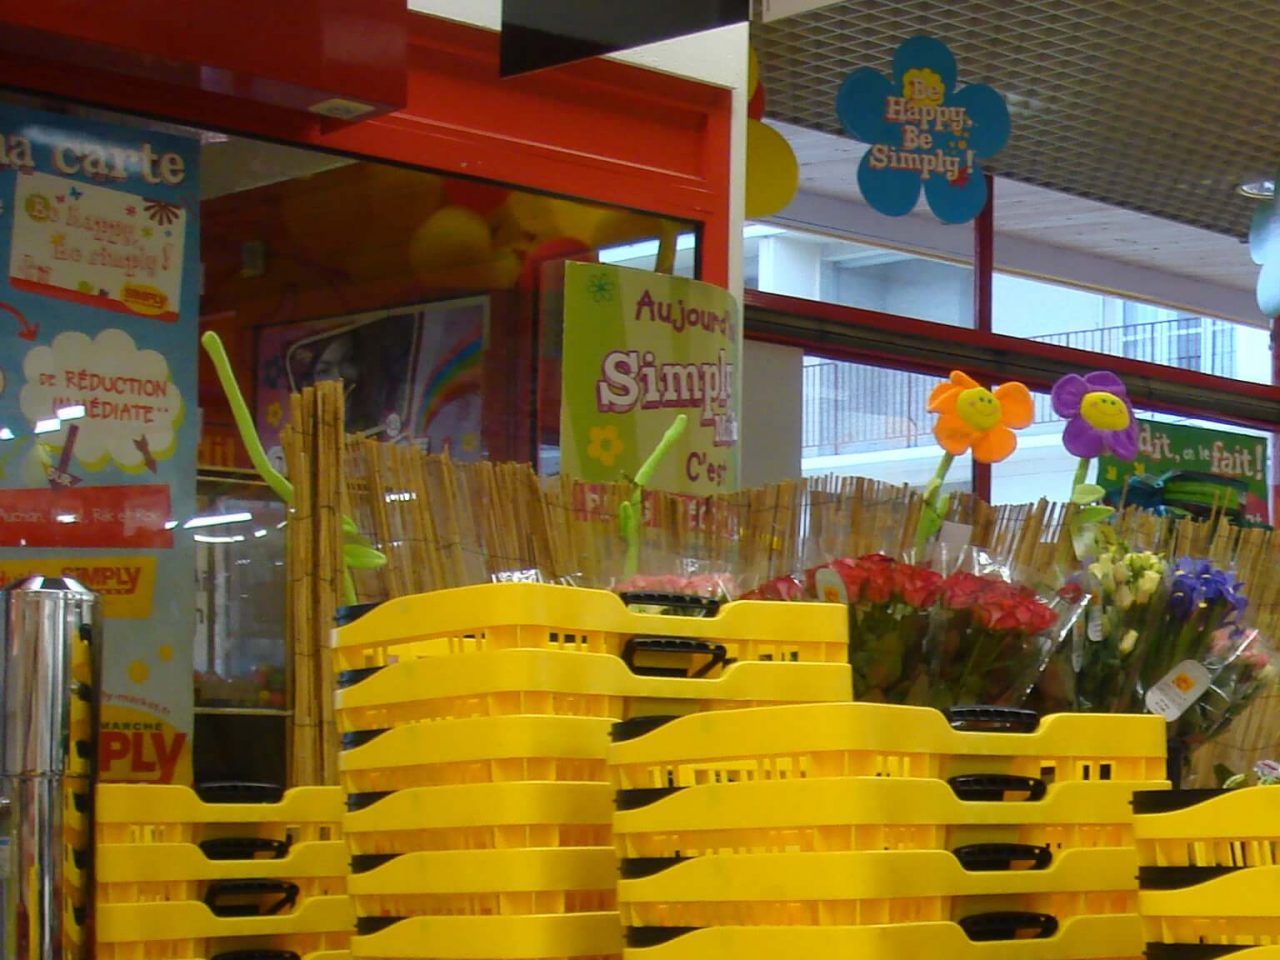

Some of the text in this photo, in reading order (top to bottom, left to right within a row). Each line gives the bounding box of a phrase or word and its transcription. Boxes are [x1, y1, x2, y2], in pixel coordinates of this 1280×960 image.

[911, 77, 940, 100] Be
[886, 96, 973, 131] Happy,
[902, 125, 933, 149] Be
[53, 142, 185, 186] carte
[868, 143, 960, 181] Simply
[65, 369, 168, 398] RÉDUCTION
[101, 731, 188, 785] PLY
